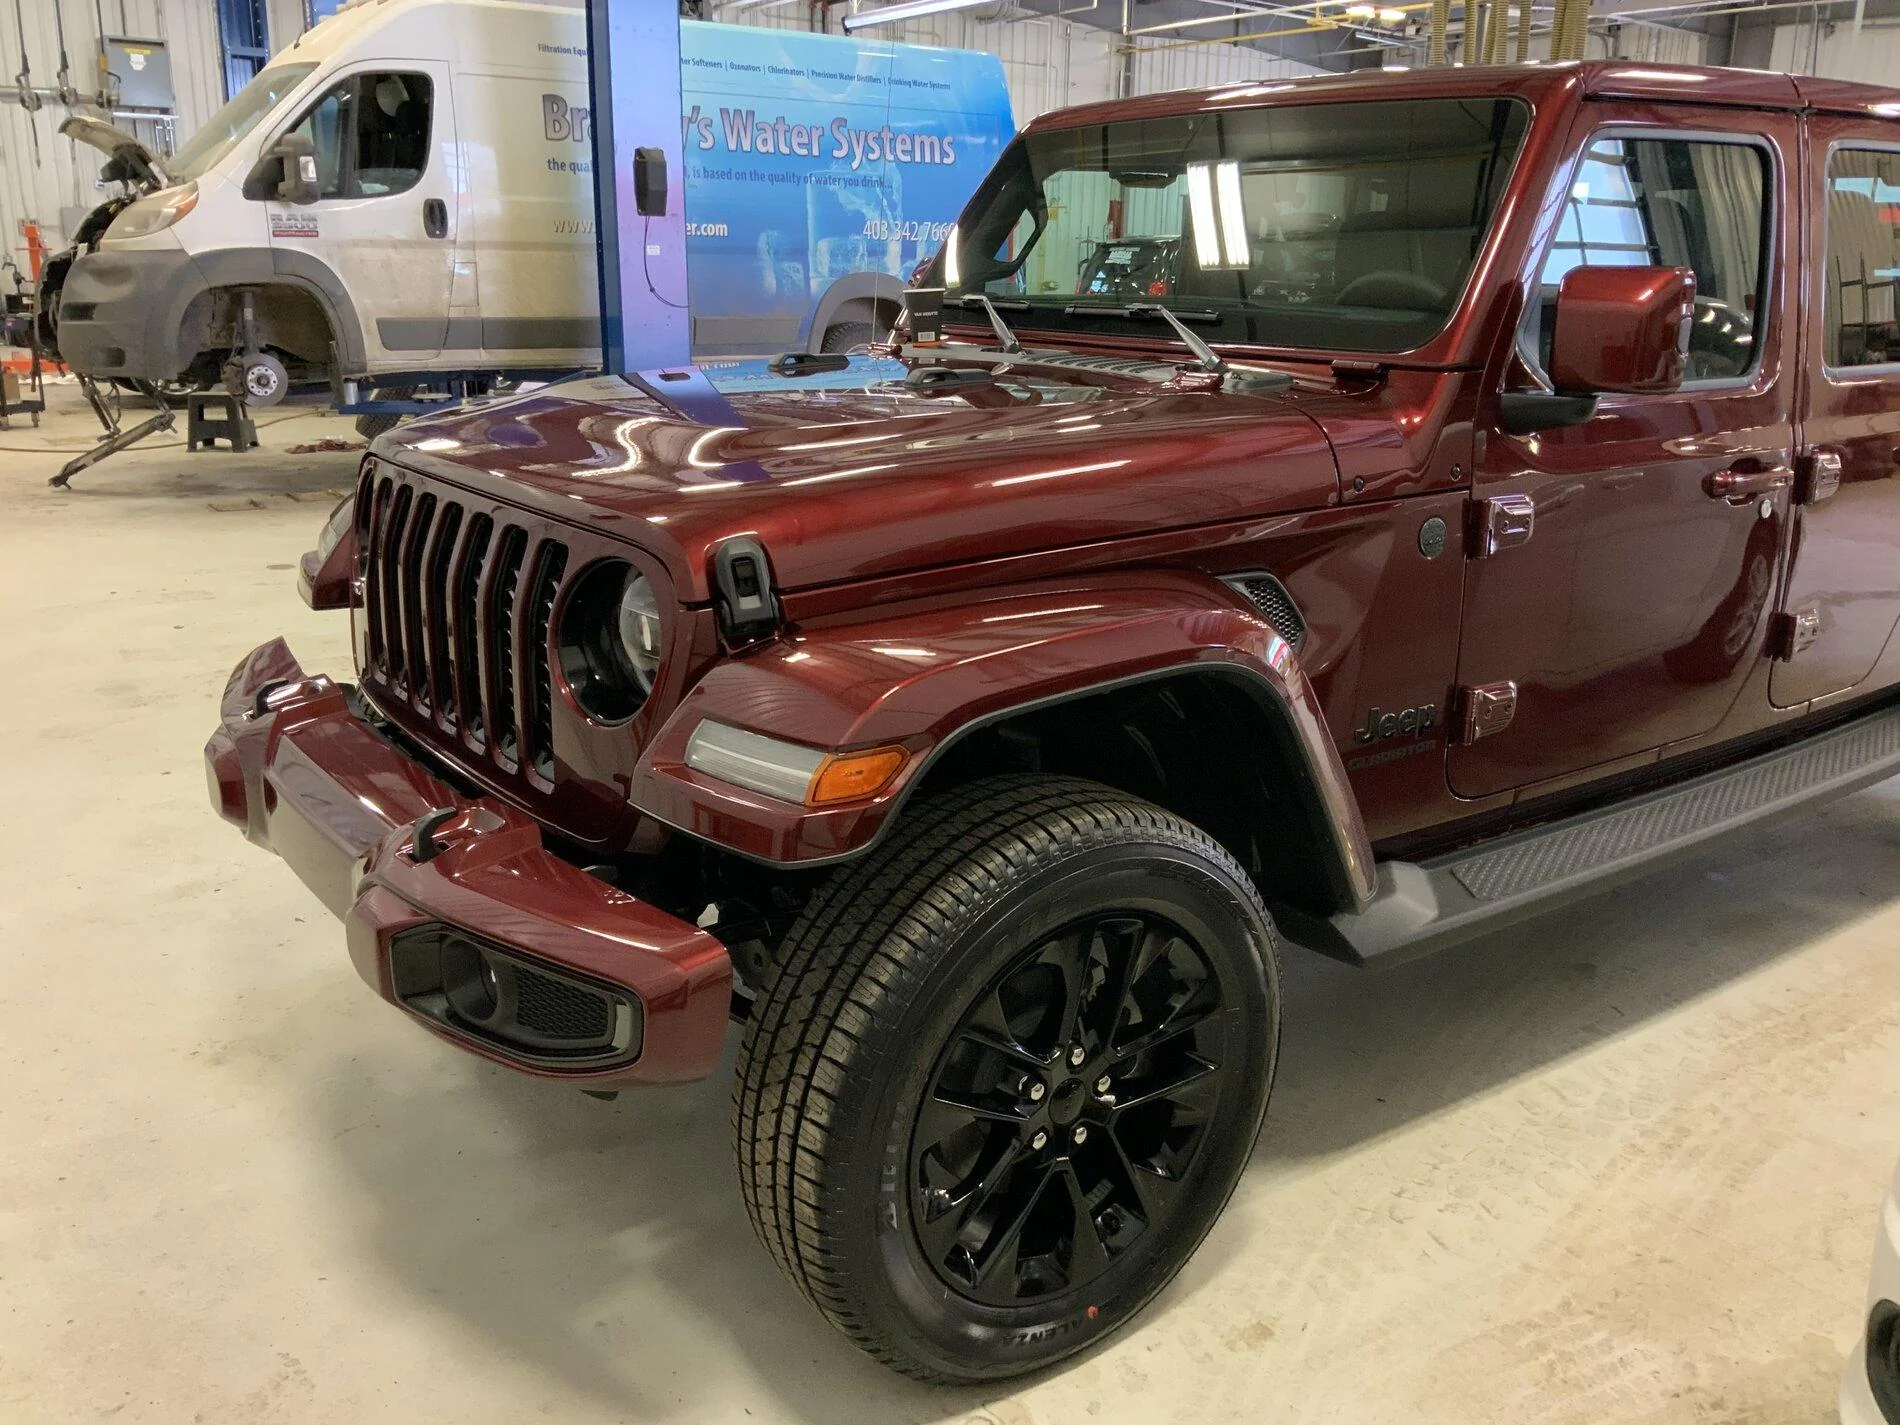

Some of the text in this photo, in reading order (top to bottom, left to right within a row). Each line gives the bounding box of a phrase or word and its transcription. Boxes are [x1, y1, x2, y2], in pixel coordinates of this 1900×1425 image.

[538, 43, 572, 55] Filtration
[692, 58, 723, 69] Softeners
[729, 61, 761, 72] Ozonators
[767, 65, 805, 77] Chlorinators
[811, 69, 882, 84] Precision Water Distillers
[912, 80, 929, 89] Water
[929, 80, 951, 91] Systems
[719, 107, 824, 158] Water
[830, 116, 956, 171] Systems
[547, 157, 568, 172] the
[692, 166, 701, 179] is
[702, 166, 733, 181] based
[734, 170, 748, 182] on
[749, 169, 766, 183] the
[767, 170, 801, 187] quality
[803, 172, 815, 184] of
[815, 176, 842, 187] water
[843, 177, 860, 190] you
[1353, 703, 1435, 745] Jeep
